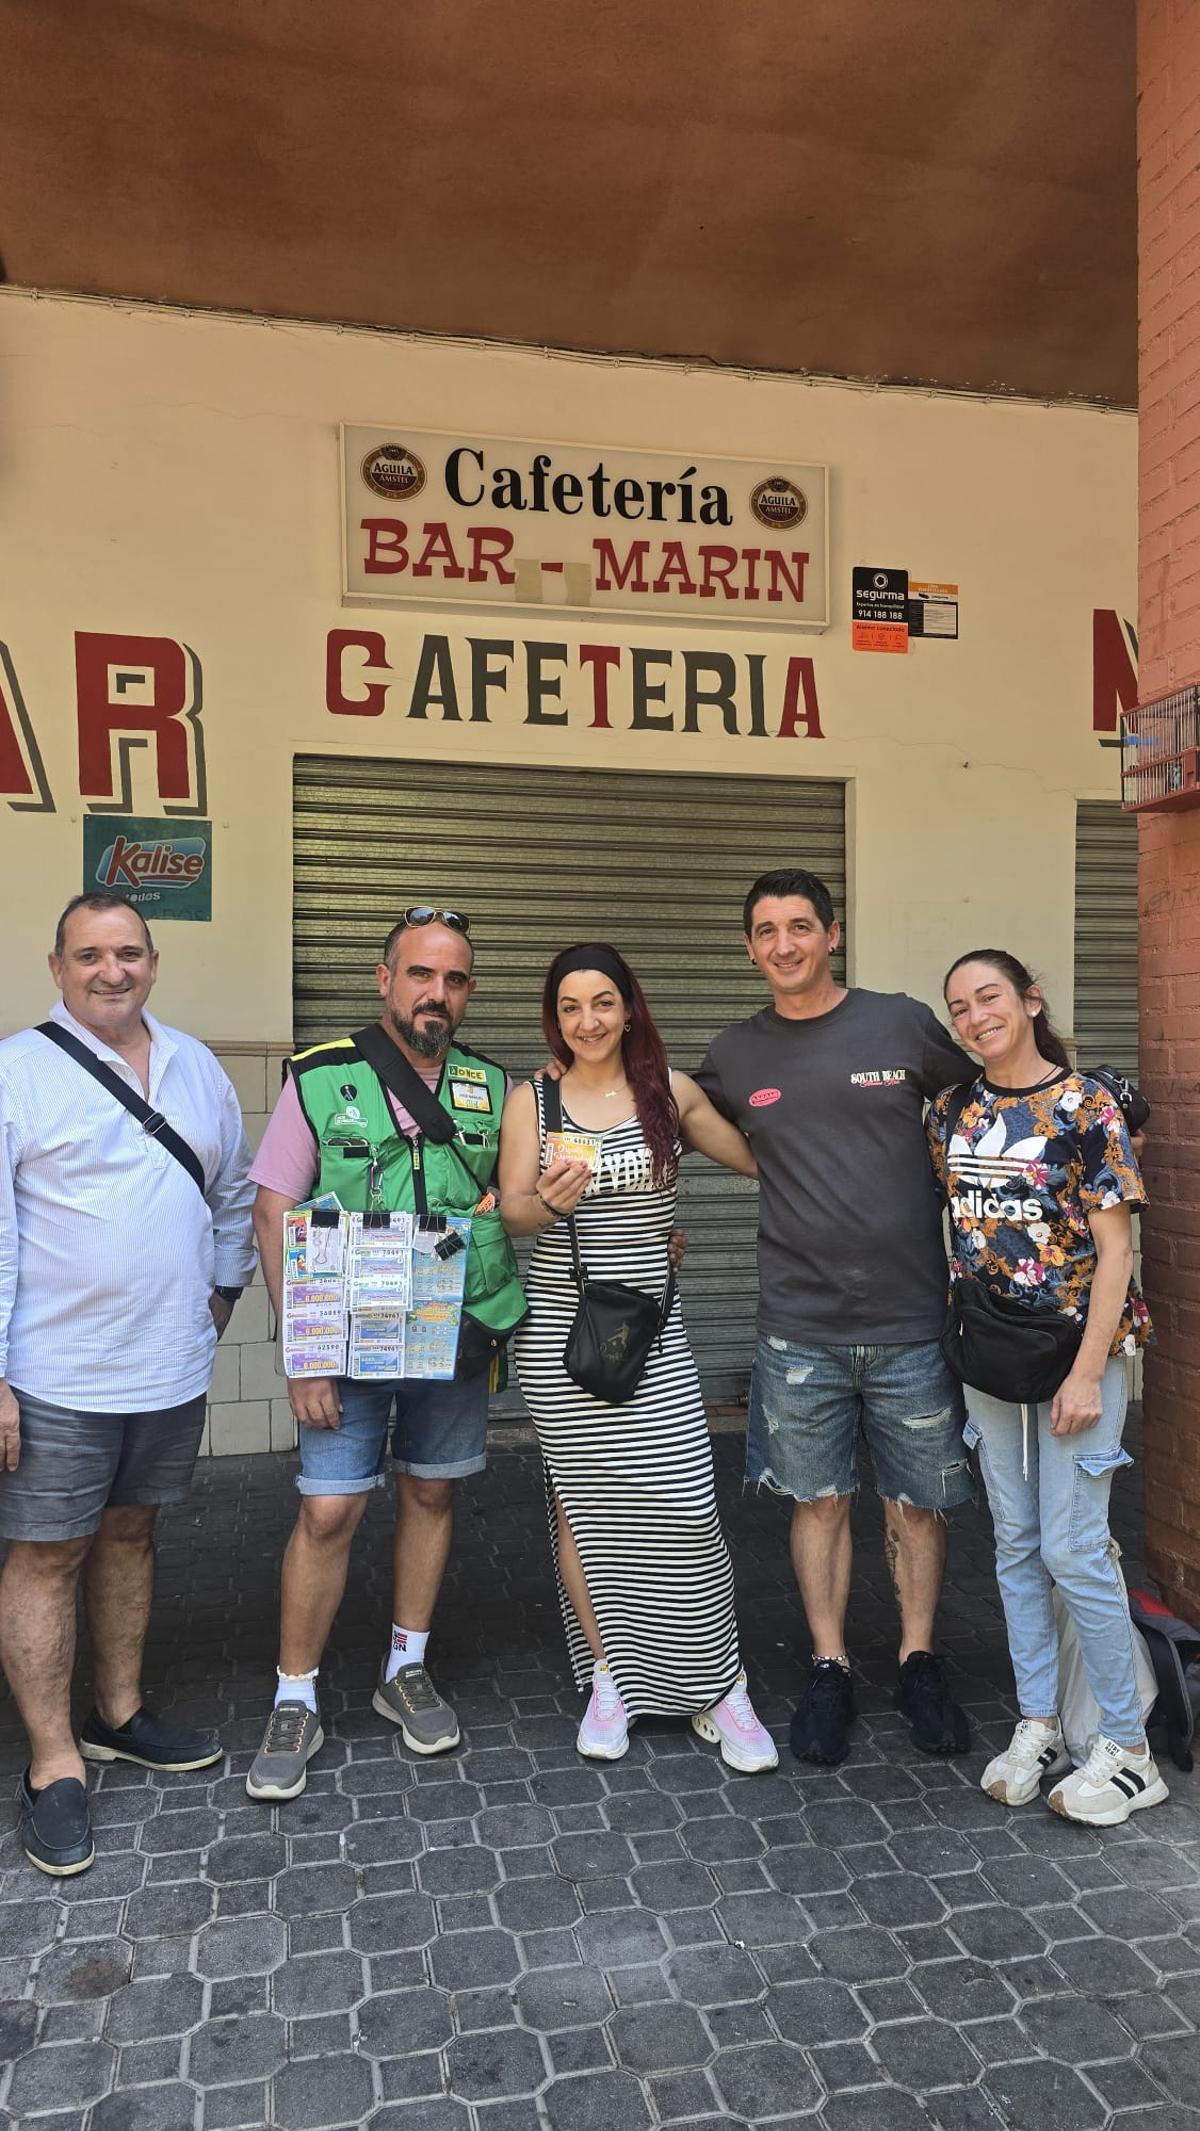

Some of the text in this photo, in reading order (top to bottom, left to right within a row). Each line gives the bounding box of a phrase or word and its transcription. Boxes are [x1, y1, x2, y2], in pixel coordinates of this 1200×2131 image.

[445, 446, 733, 527] Cafetería
[360, 518, 516, 585] BAR
[592, 537, 810, 603] MARIN
[856, 589, 905, 601] segurma
[858, 609, 903, 620] 914 188 188
[325, 628, 826, 738] CAFETERIA
[105, 836, 204, 888] Kalise
[458, 1068, 484, 1080] ONCE
[850, 1071, 880, 1085] SOUTH
[881, 1069, 906, 1081] BEACH
